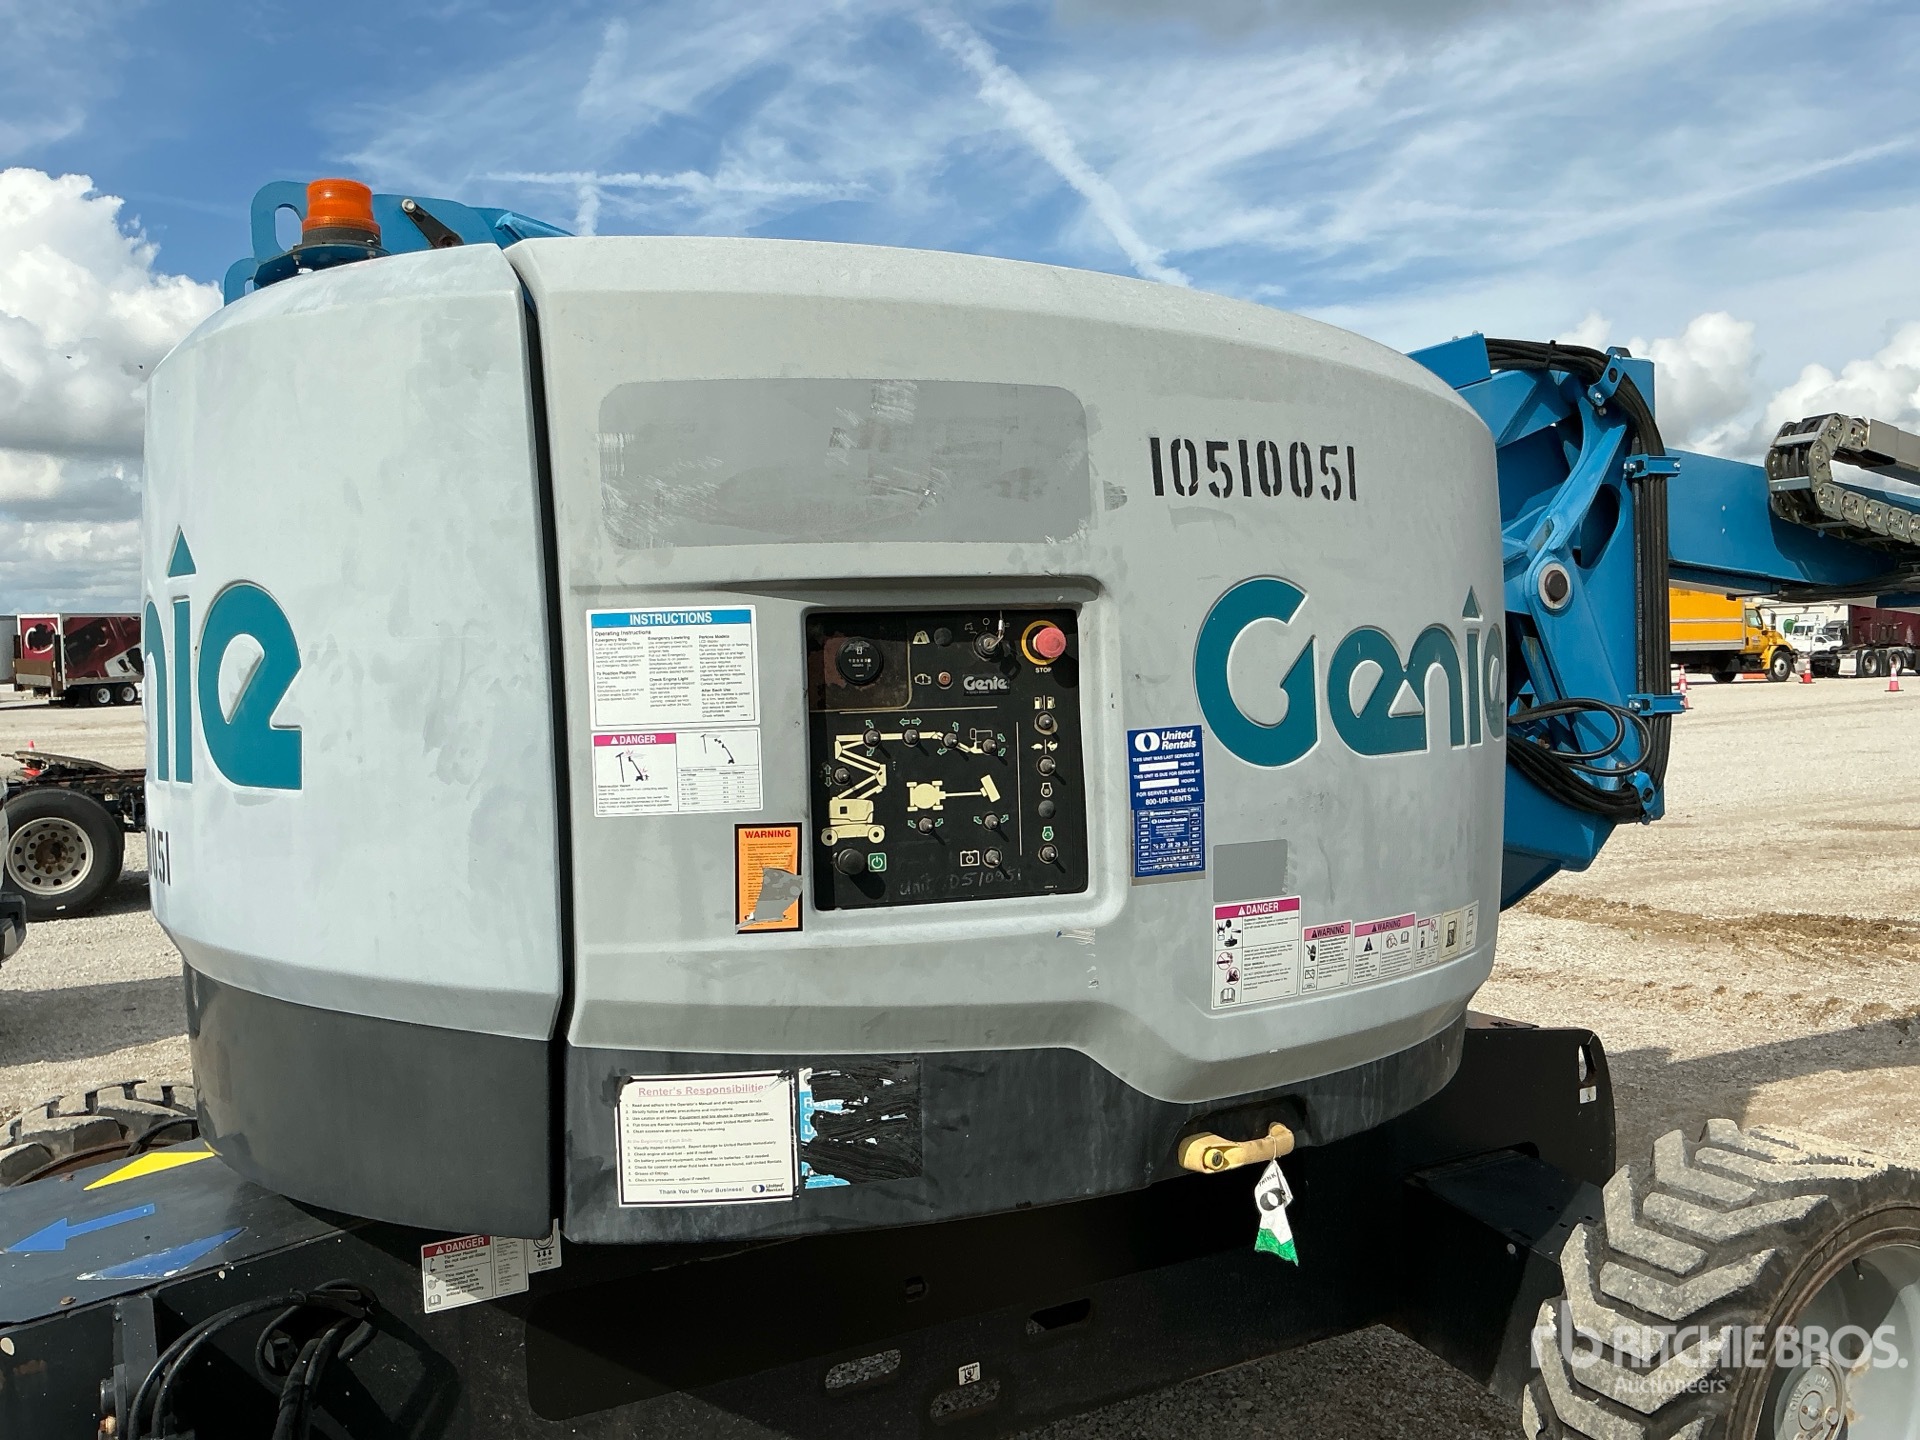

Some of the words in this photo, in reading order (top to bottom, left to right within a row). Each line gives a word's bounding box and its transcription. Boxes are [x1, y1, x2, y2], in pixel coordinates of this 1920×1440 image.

[1149, 437, 1357, 501] 10510051
[629, 612, 712, 626] INSTRUCTIONS
[1193, 574, 1505, 771] Genie
[964, 675, 1009, 691] Genie
[620, 735, 656, 744] DANGER
[1162, 730, 1193, 740] United
[1162, 739, 1196, 750] Rentals
[1146, 795, 1192, 805] 800-UR-RENTS
[745, 830, 791, 838] WARNING
[1246, 902, 1278, 914] DANGER
[1377, 920, 1400, 930] WARNING
[1317, 926, 1344, 937] WARNING
[638, 1087, 682, 1096] Renter's
[1259, 1173, 1277, 1187] THINK
[446, 1237, 484, 1252] DANGER
